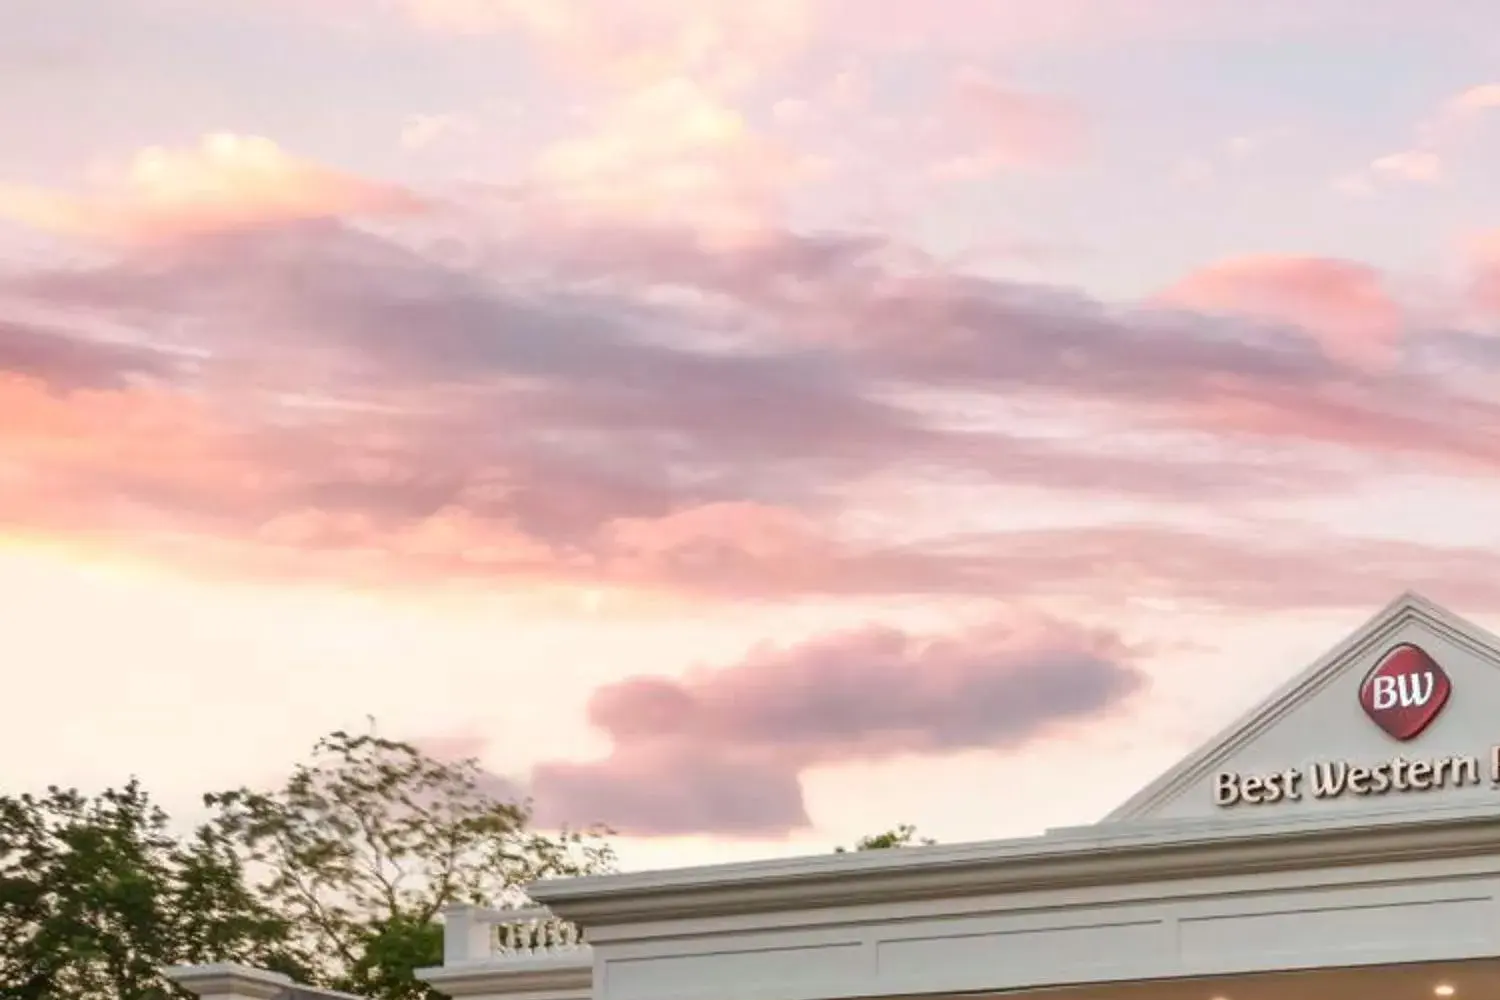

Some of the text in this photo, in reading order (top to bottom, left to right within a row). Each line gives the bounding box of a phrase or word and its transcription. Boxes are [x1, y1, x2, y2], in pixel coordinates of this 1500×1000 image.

[1373, 672, 1433, 710] BW
[1214, 767, 1302, 807] Best
[1310, 753, 1480, 799] Western
